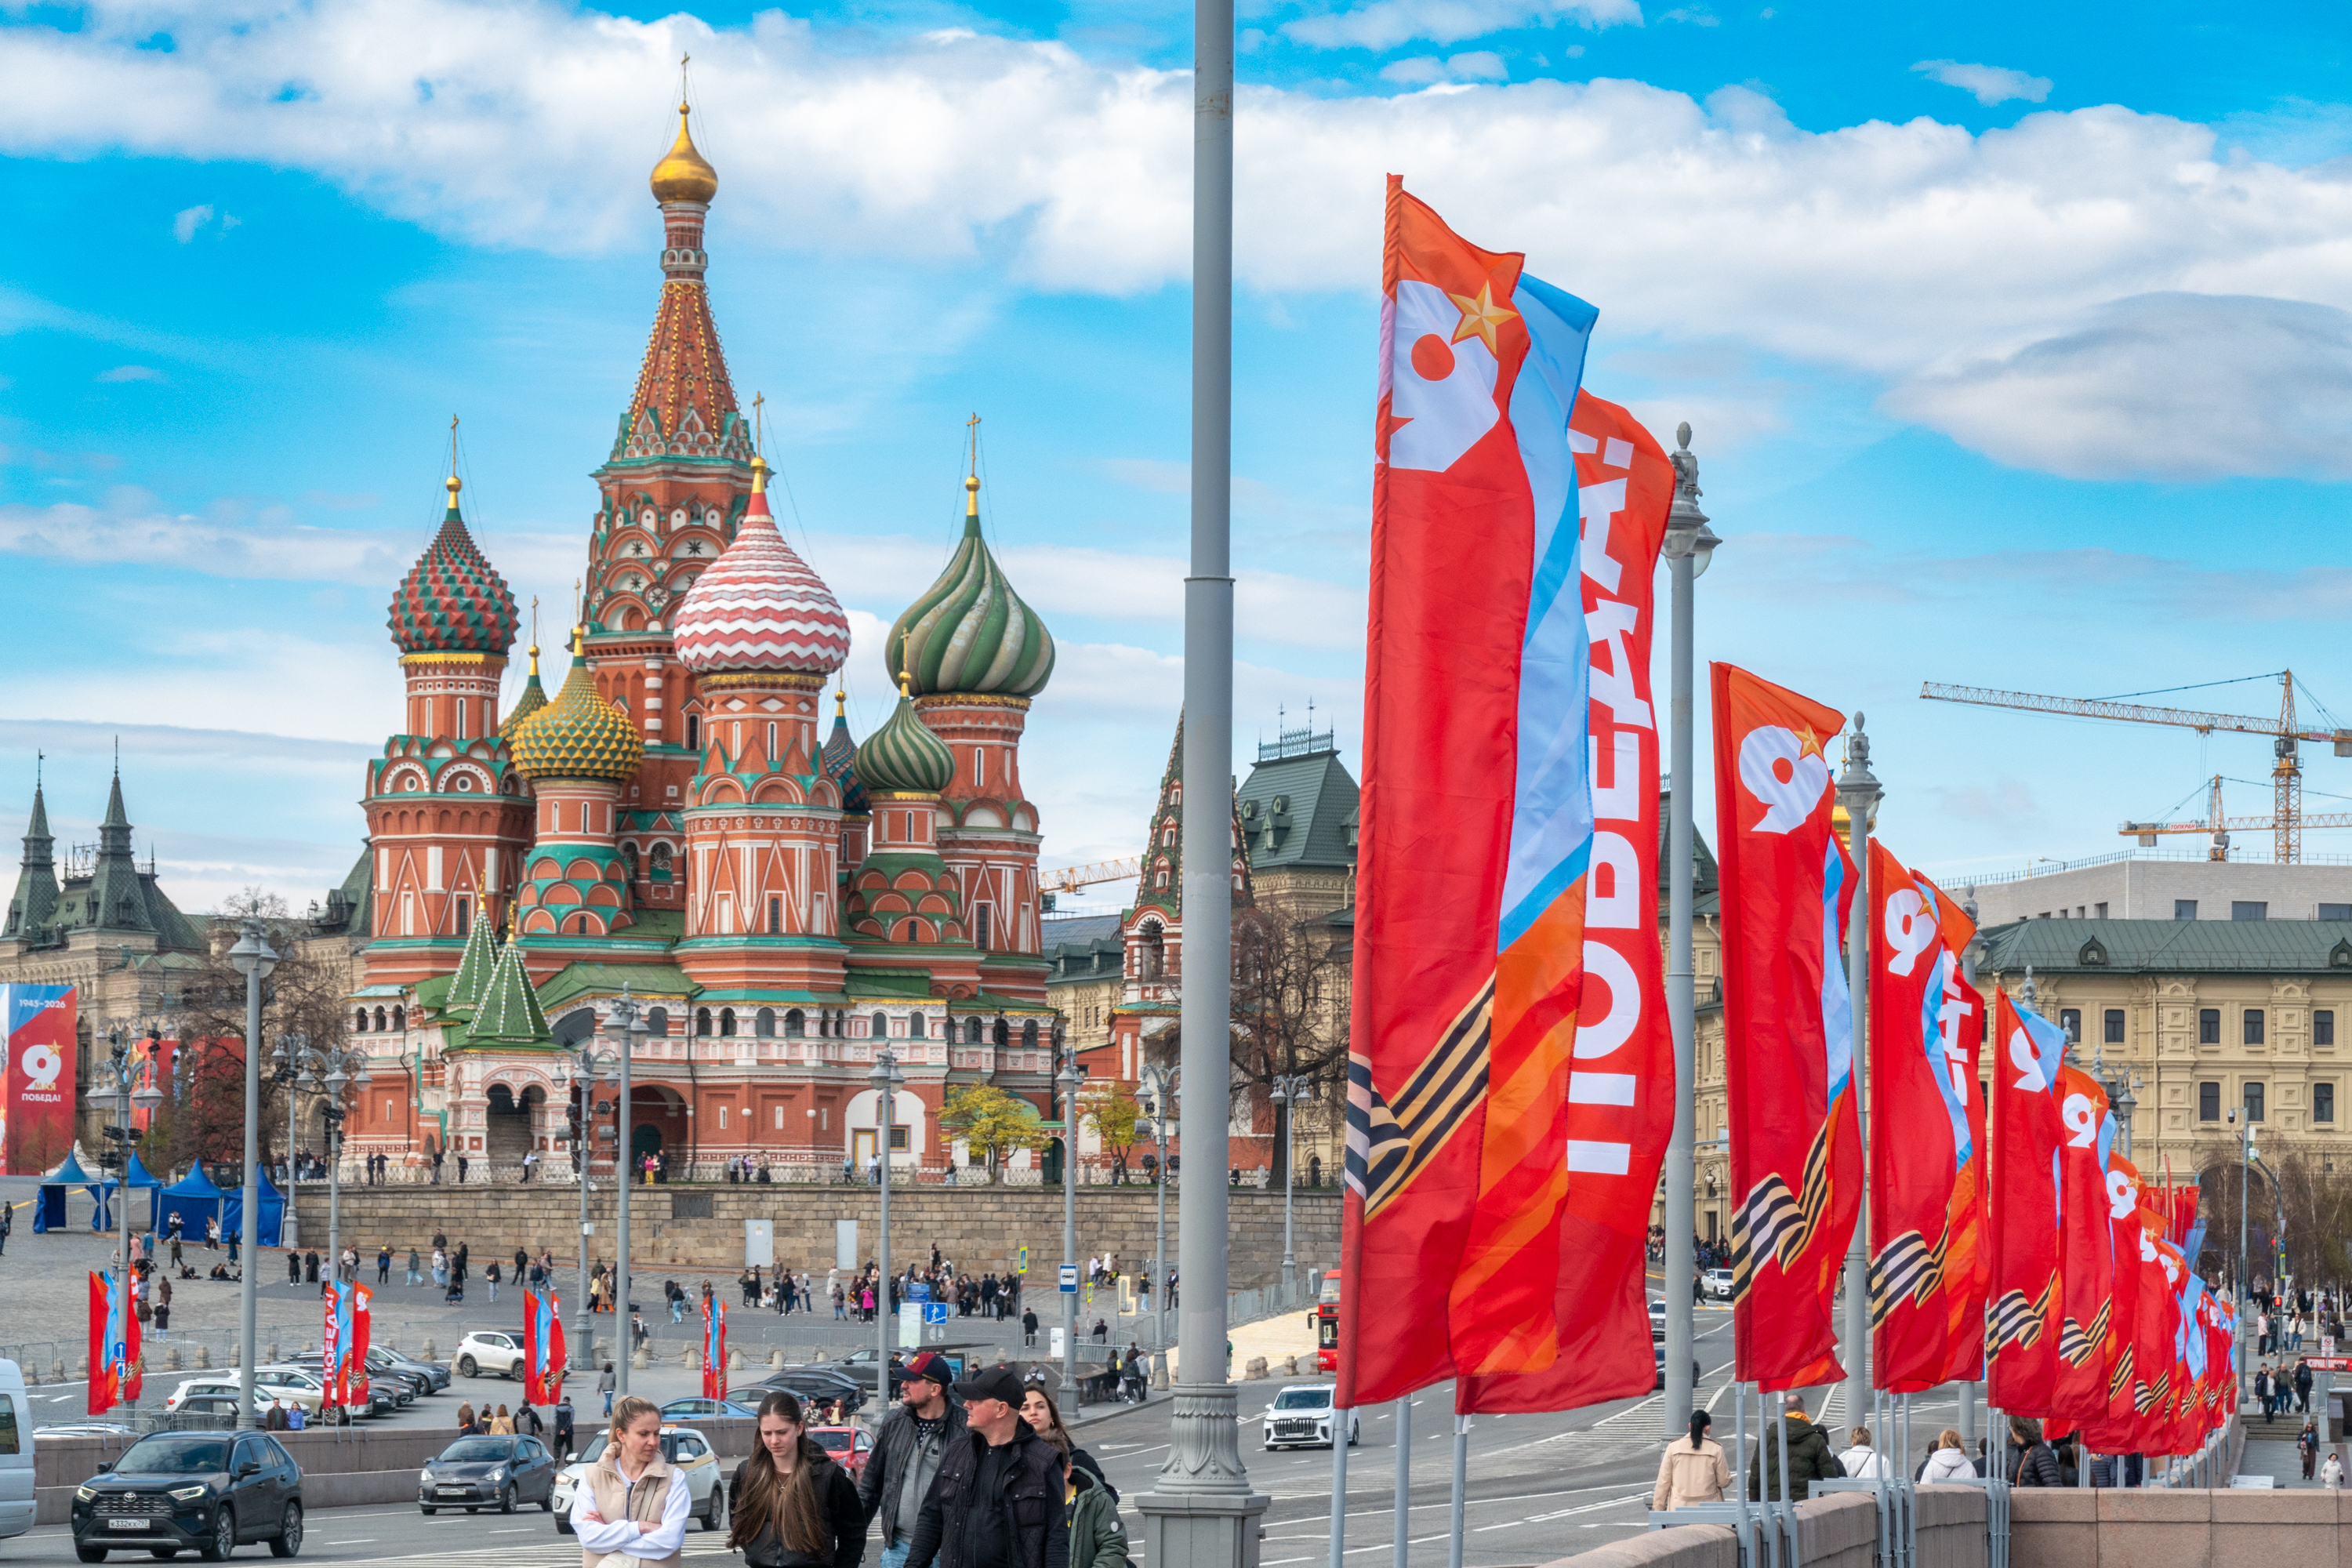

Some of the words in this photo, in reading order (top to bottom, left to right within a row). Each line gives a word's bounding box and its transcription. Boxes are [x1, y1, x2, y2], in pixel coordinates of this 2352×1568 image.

[2310, 731, 2331, 740] ТОПКРАН
[1739, 724, 1828, 834] 9
[1885, 888, 1936, 976] 9
[22, 1044, 61, 1090] 9
[34, 1082, 56, 1091] МАЯ
[21, 1093, 61, 1103] ПОБЕДА!
[2062, 1093, 2096, 1149] 9
[2107, 1171, 2138, 1219] 9
